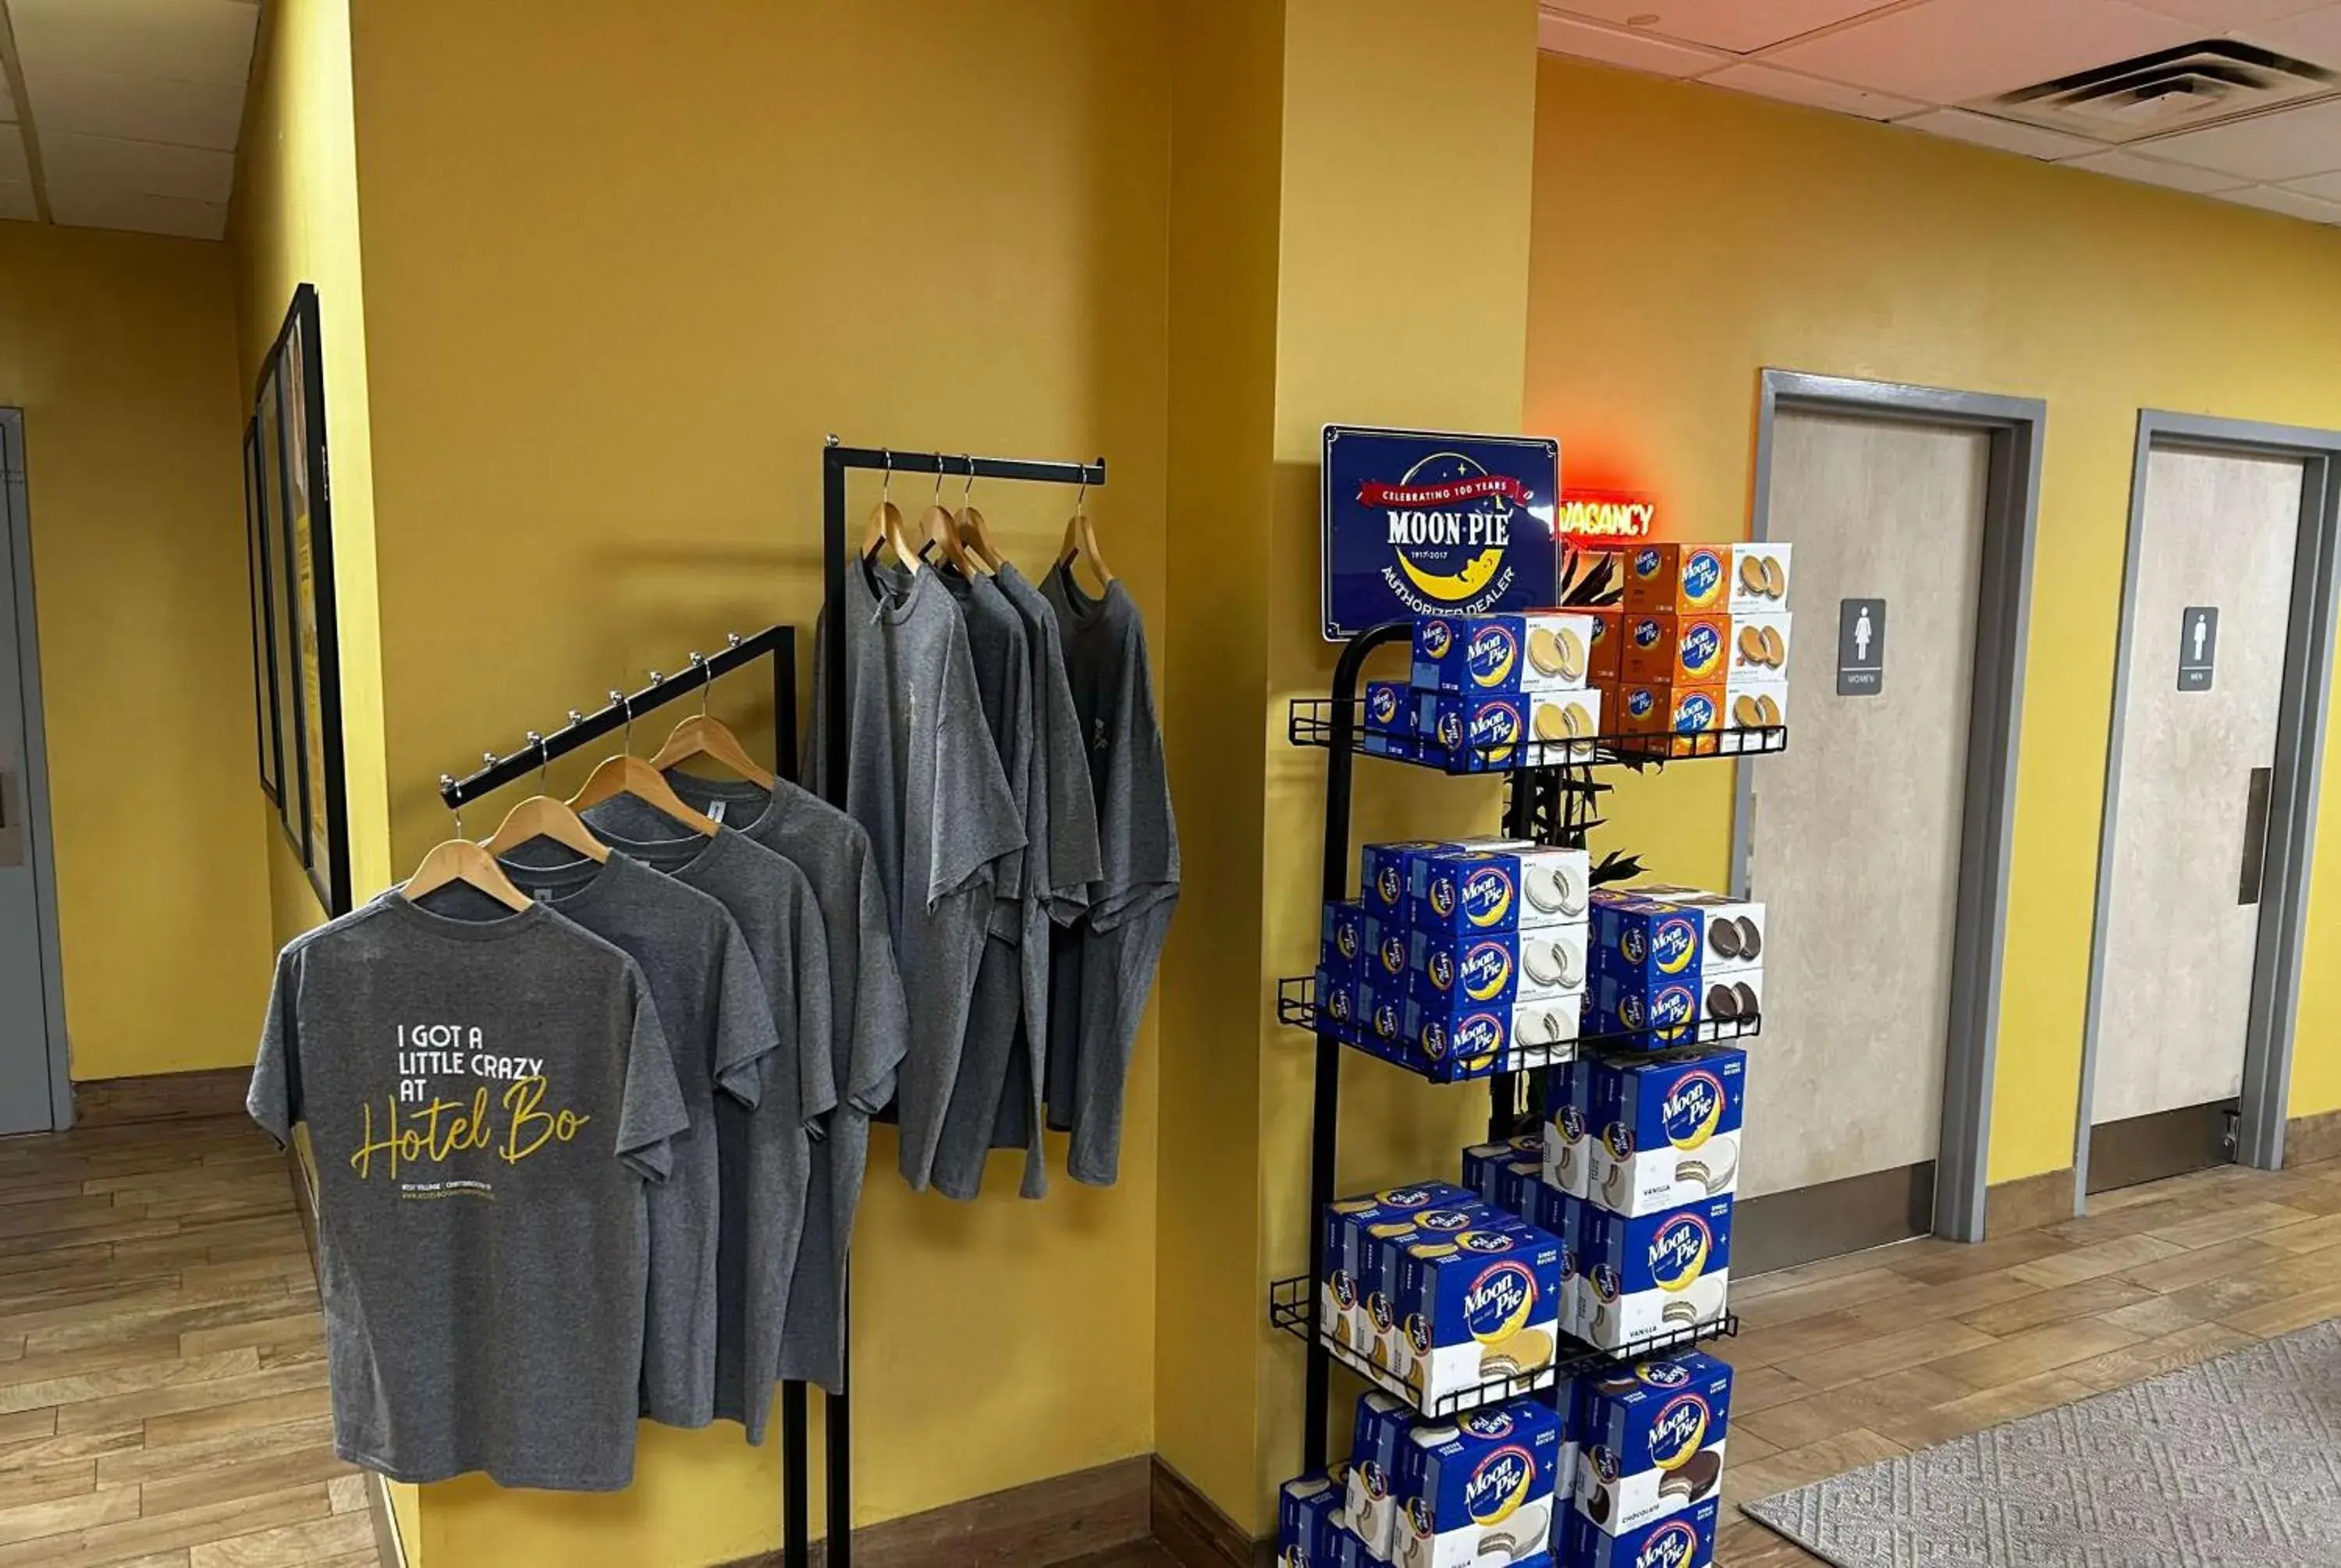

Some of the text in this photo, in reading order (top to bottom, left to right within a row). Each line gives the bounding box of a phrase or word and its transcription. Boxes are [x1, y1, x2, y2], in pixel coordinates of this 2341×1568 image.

[1382, 481, 1507, 502] CELEBRATING 100 YEARS
[1387, 509, 1512, 546] MOON PIE
[1559, 501, 1654, 537] VACANCY
[1411, 551, 1448, 559] 1917-2017
[1466, 566, 1516, 616] DEALER
[1466, 634, 1501, 662] Moon
[1487, 646, 1508, 666] Pie
[1469, 711, 1504, 739] Moon
[1491, 722, 1512, 743] Pie
[1462, 875, 1496, 904] Moon
[1483, 886, 1503, 907] Pie
[1652, 927, 1682, 953] Moon
[1460, 951, 1495, 978] Moon
[1483, 960, 1502, 981] Pie
[1650, 994, 1681, 1020] Moon
[397, 1024, 483, 1049] I GOT A
[1452, 1021, 1487, 1050] Moon
[1474, 1031, 1494, 1052] Pie
[399, 1052, 544, 1081] LITTLE CRAZY
[400, 1079, 427, 1102] AT
[1661, 1082, 1703, 1124] Moon
[1689, 1096, 1712, 1126] Pie
[350, 1074, 591, 1180] Hotel Bo
[1647, 1225, 1691, 1268] Moon
[1675, 1238, 1700, 1268] Pie
[1463, 1272, 1513, 1320] Moon
[1494, 1288, 1522, 1320] Pie
[1647, 1405, 1690, 1448] Moon
[1673, 1417, 1697, 1446] Pie
[1463, 1456, 1512, 1506] Moon
[1494, 1470, 1521, 1502] Pie
[1636, 1531, 1678, 1568] Moon
